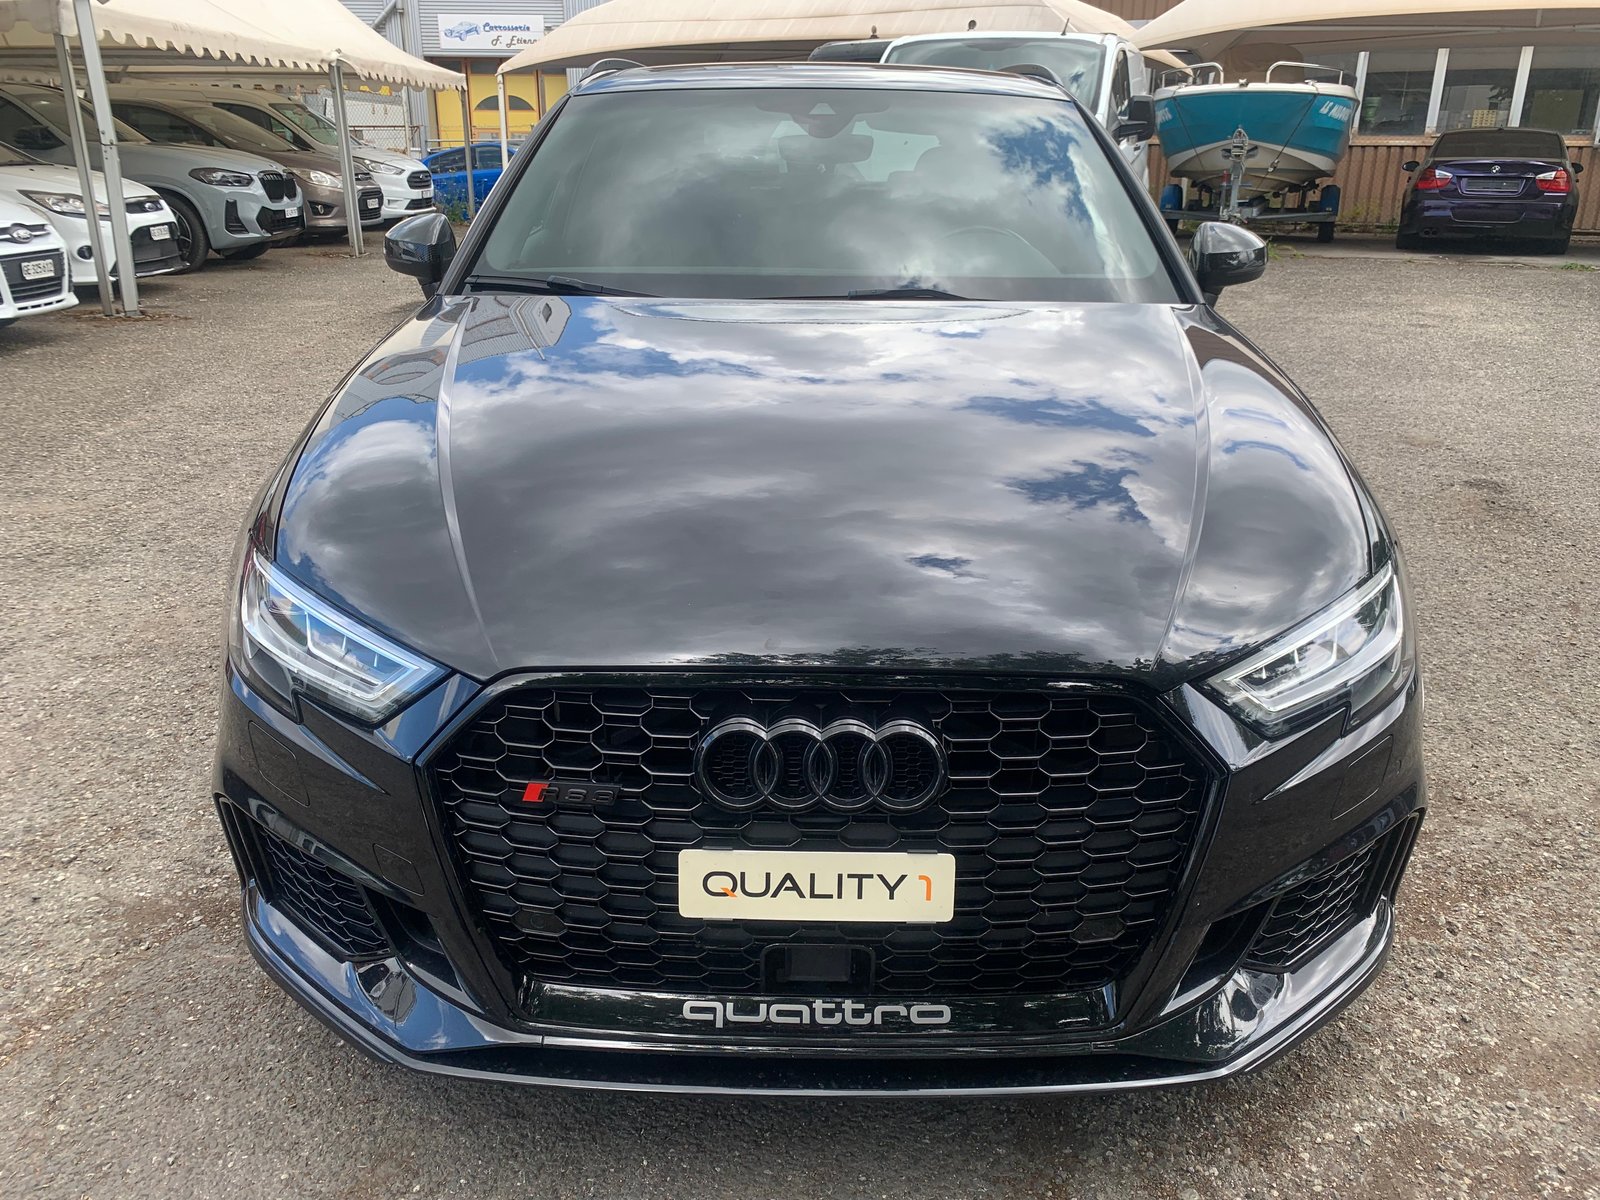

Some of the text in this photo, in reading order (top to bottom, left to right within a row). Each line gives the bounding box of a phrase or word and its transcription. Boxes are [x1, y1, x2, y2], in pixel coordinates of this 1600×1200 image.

[483, 22, 530, 32] Carrosserie
[702, 871, 908, 900] QUALITY
[682, 999, 952, 1028] quattro
